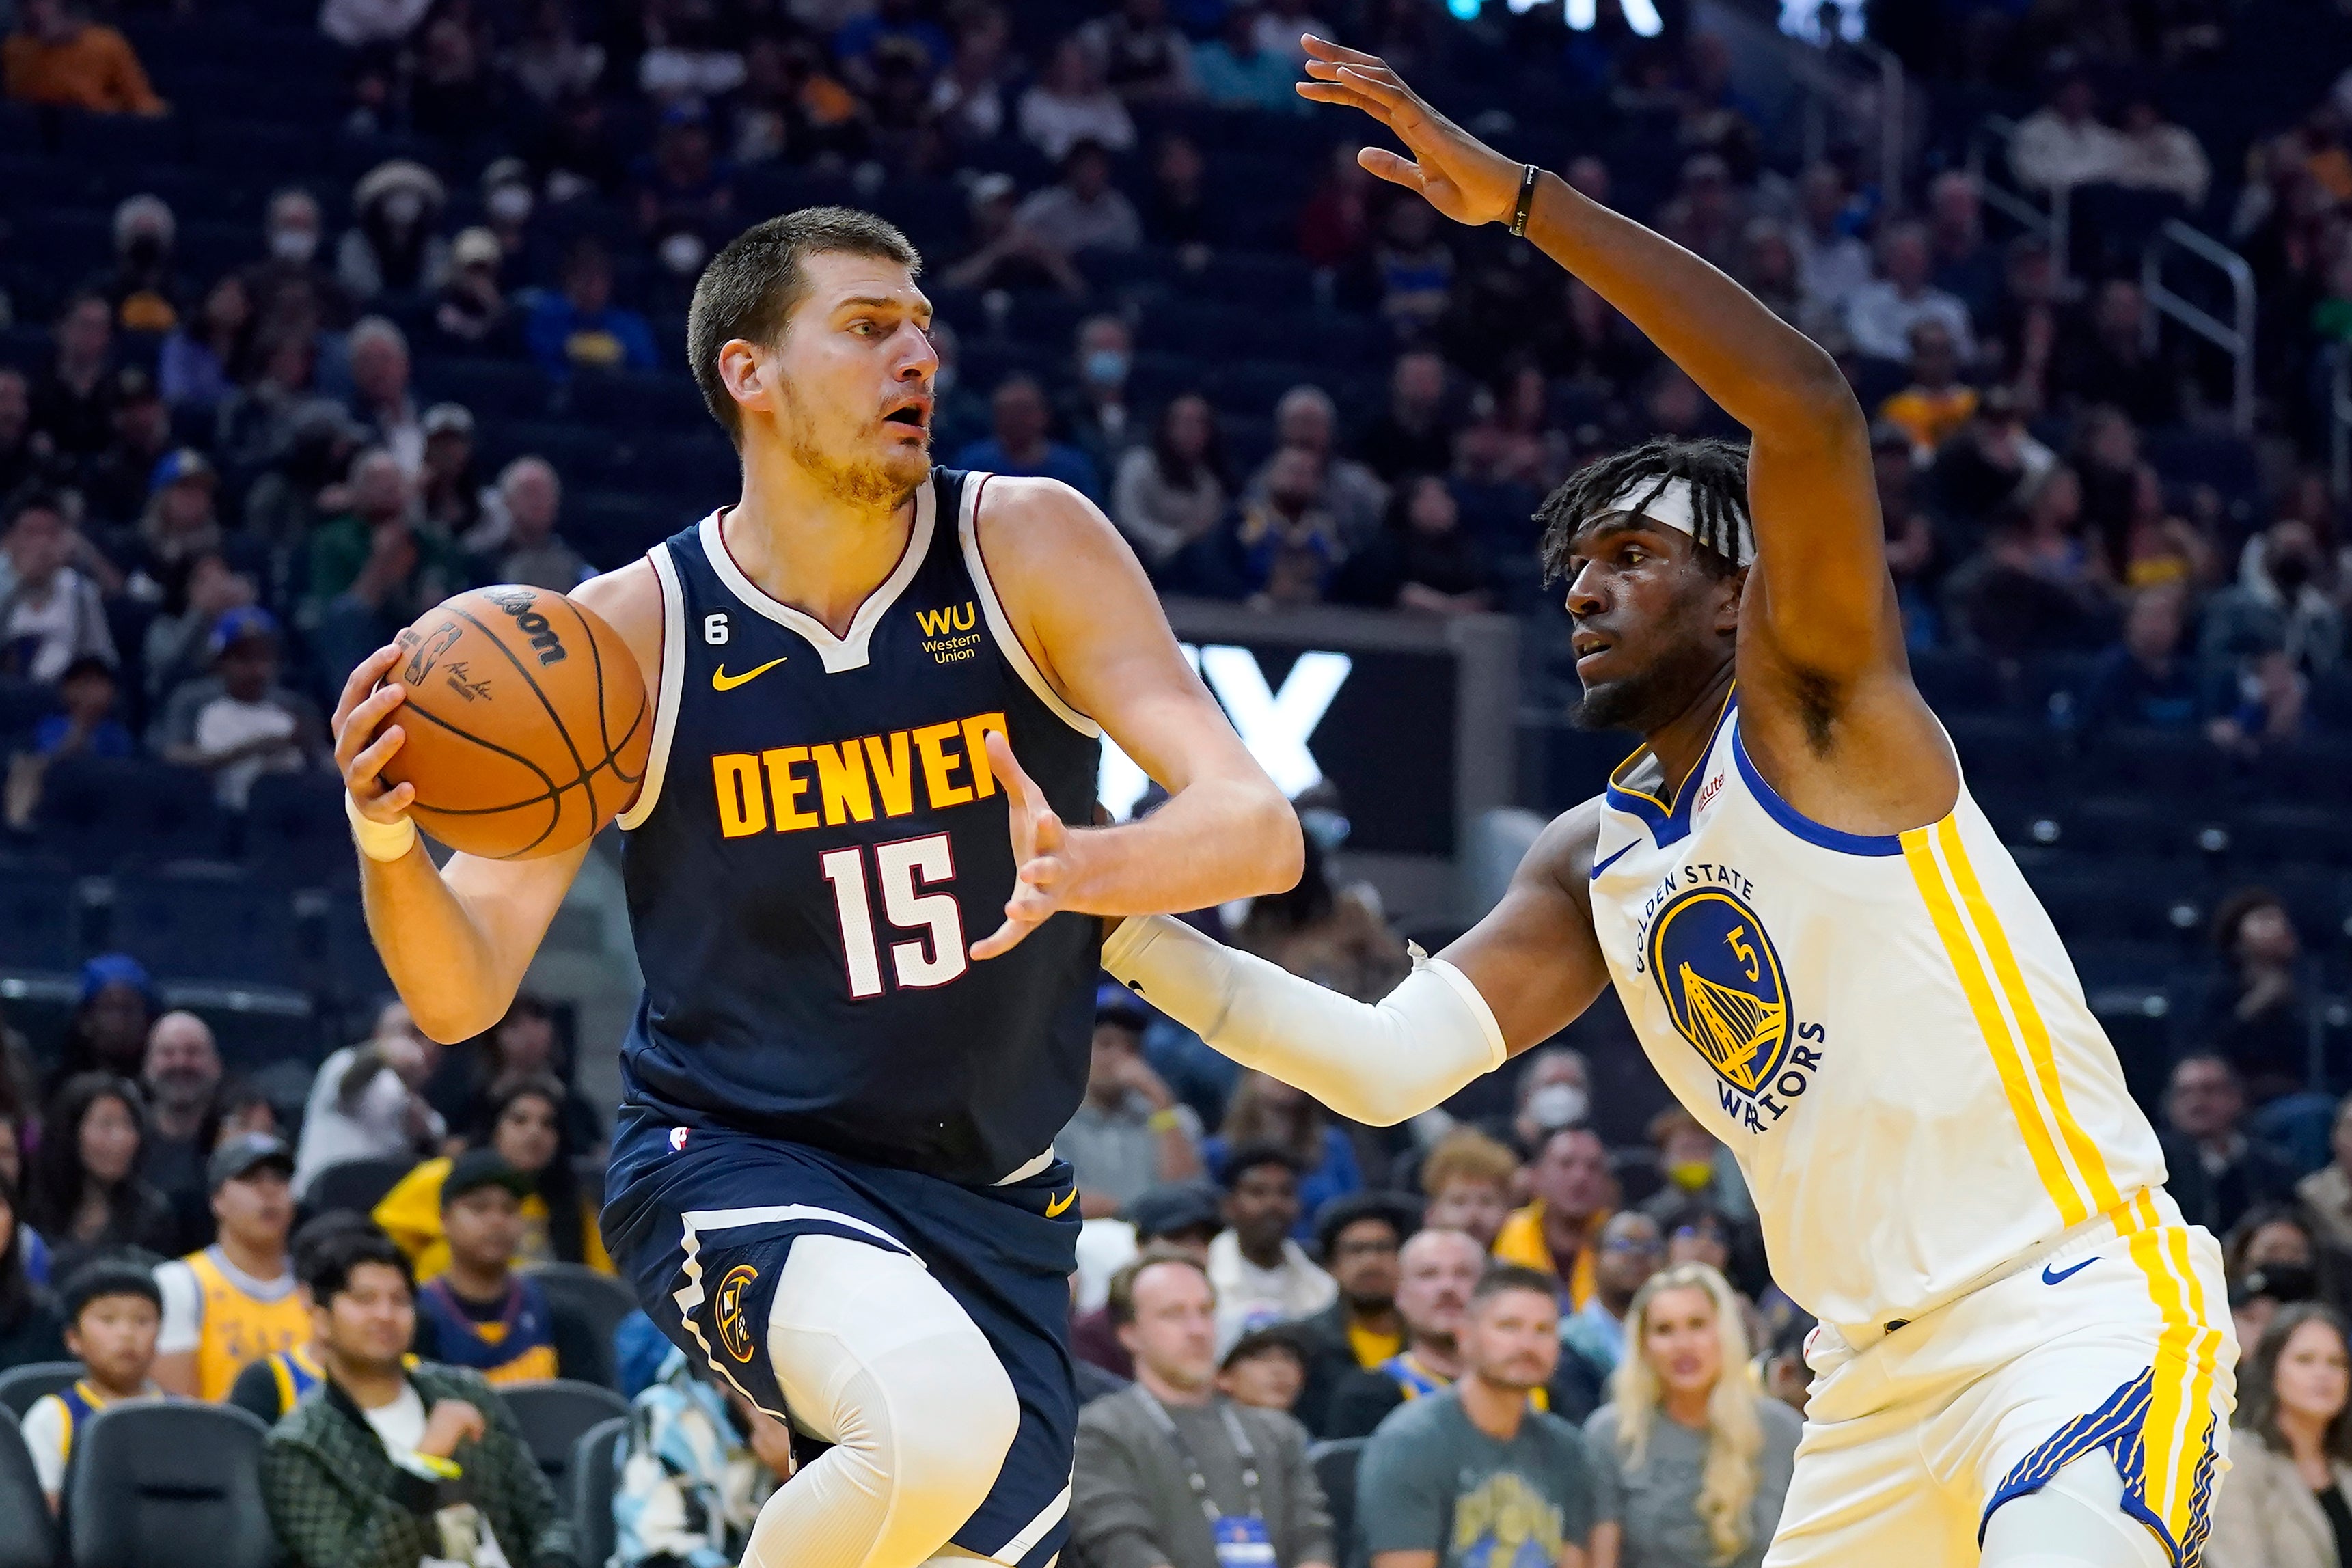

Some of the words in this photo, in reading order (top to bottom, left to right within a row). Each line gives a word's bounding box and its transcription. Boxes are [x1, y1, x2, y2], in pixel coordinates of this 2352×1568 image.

[705, 613, 728, 646] 6
[916, 601, 976, 637] WU
[922, 633, 981, 654] Western
[934, 648, 976, 665] Union
[819, 831, 970, 1000] 15
[1636, 872, 1678, 974] GOLDEN
[1684, 864, 1754, 901] STATE
[1725, 924, 1761, 983] 5
